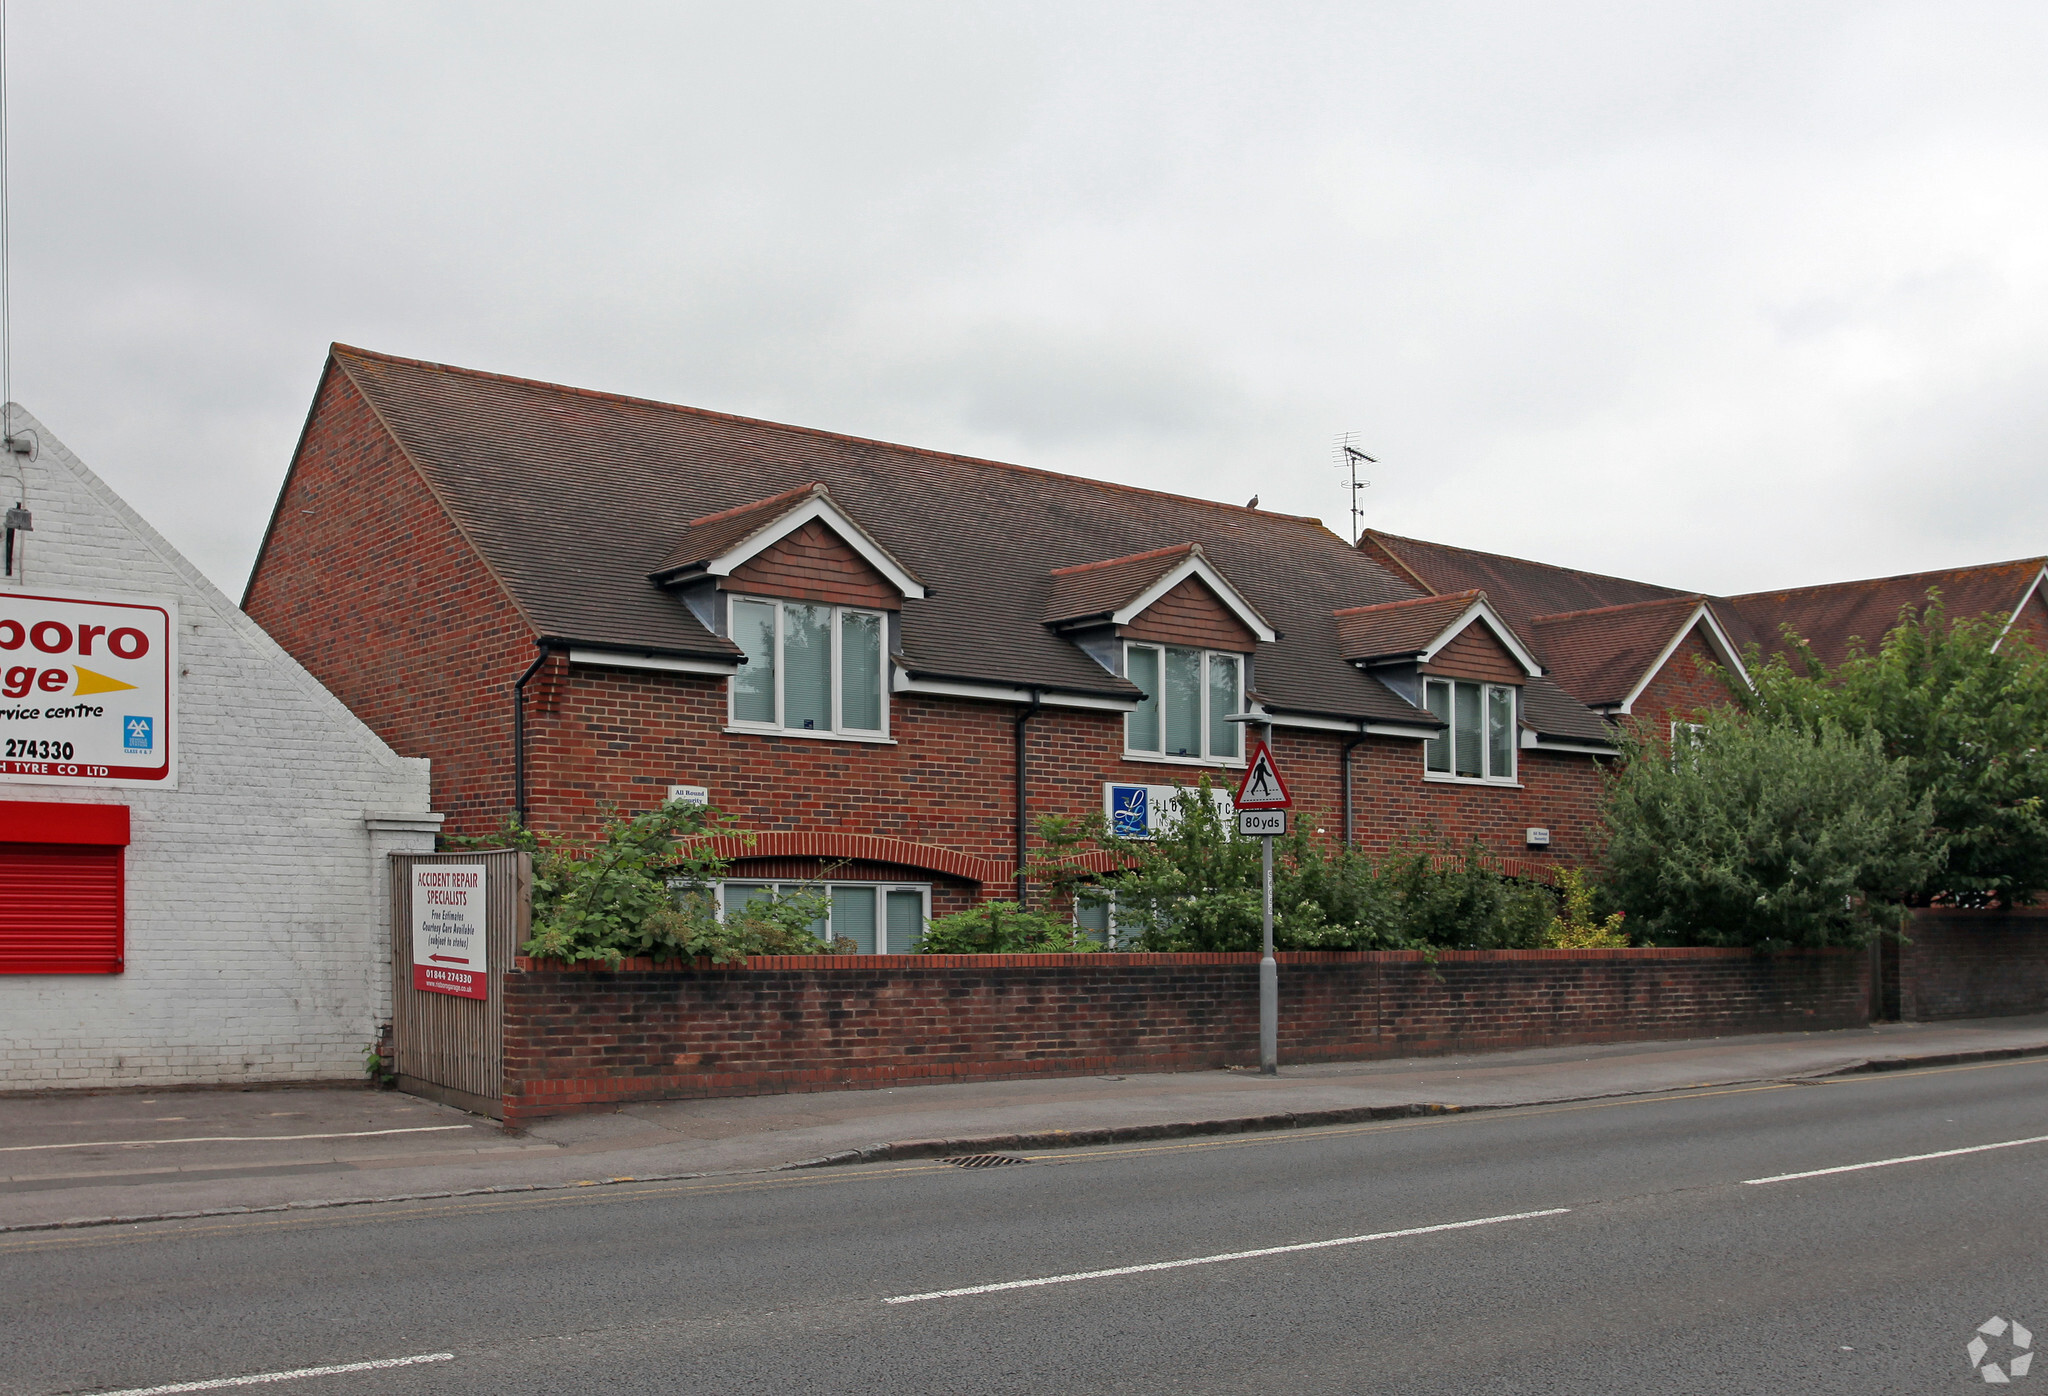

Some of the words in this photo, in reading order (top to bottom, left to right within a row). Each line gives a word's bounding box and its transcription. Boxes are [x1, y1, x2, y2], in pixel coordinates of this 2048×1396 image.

[0, 665, 69, 698] ge
[44, 703, 104, 720] centre
[5, 738, 74, 760] 274330
[14, 762, 48, 774] TYRE
[57, 764, 78, 775] CO
[86, 766, 109, 777] LTD
[418, 872, 450, 887] ACCIDENT
[452, 873, 478, 888] REPAIR
[427, 890, 467, 906] SPECIALISTS
[432, 909, 441, 920] Free
[442, 910, 464, 921] Estimates
[422, 921, 441, 935] Courtesy
[442, 923, 452, 934] Cars
[453, 924, 475, 935] Available
[425, 969, 446, 980] 01844
[447, 971, 472, 984] 274330
